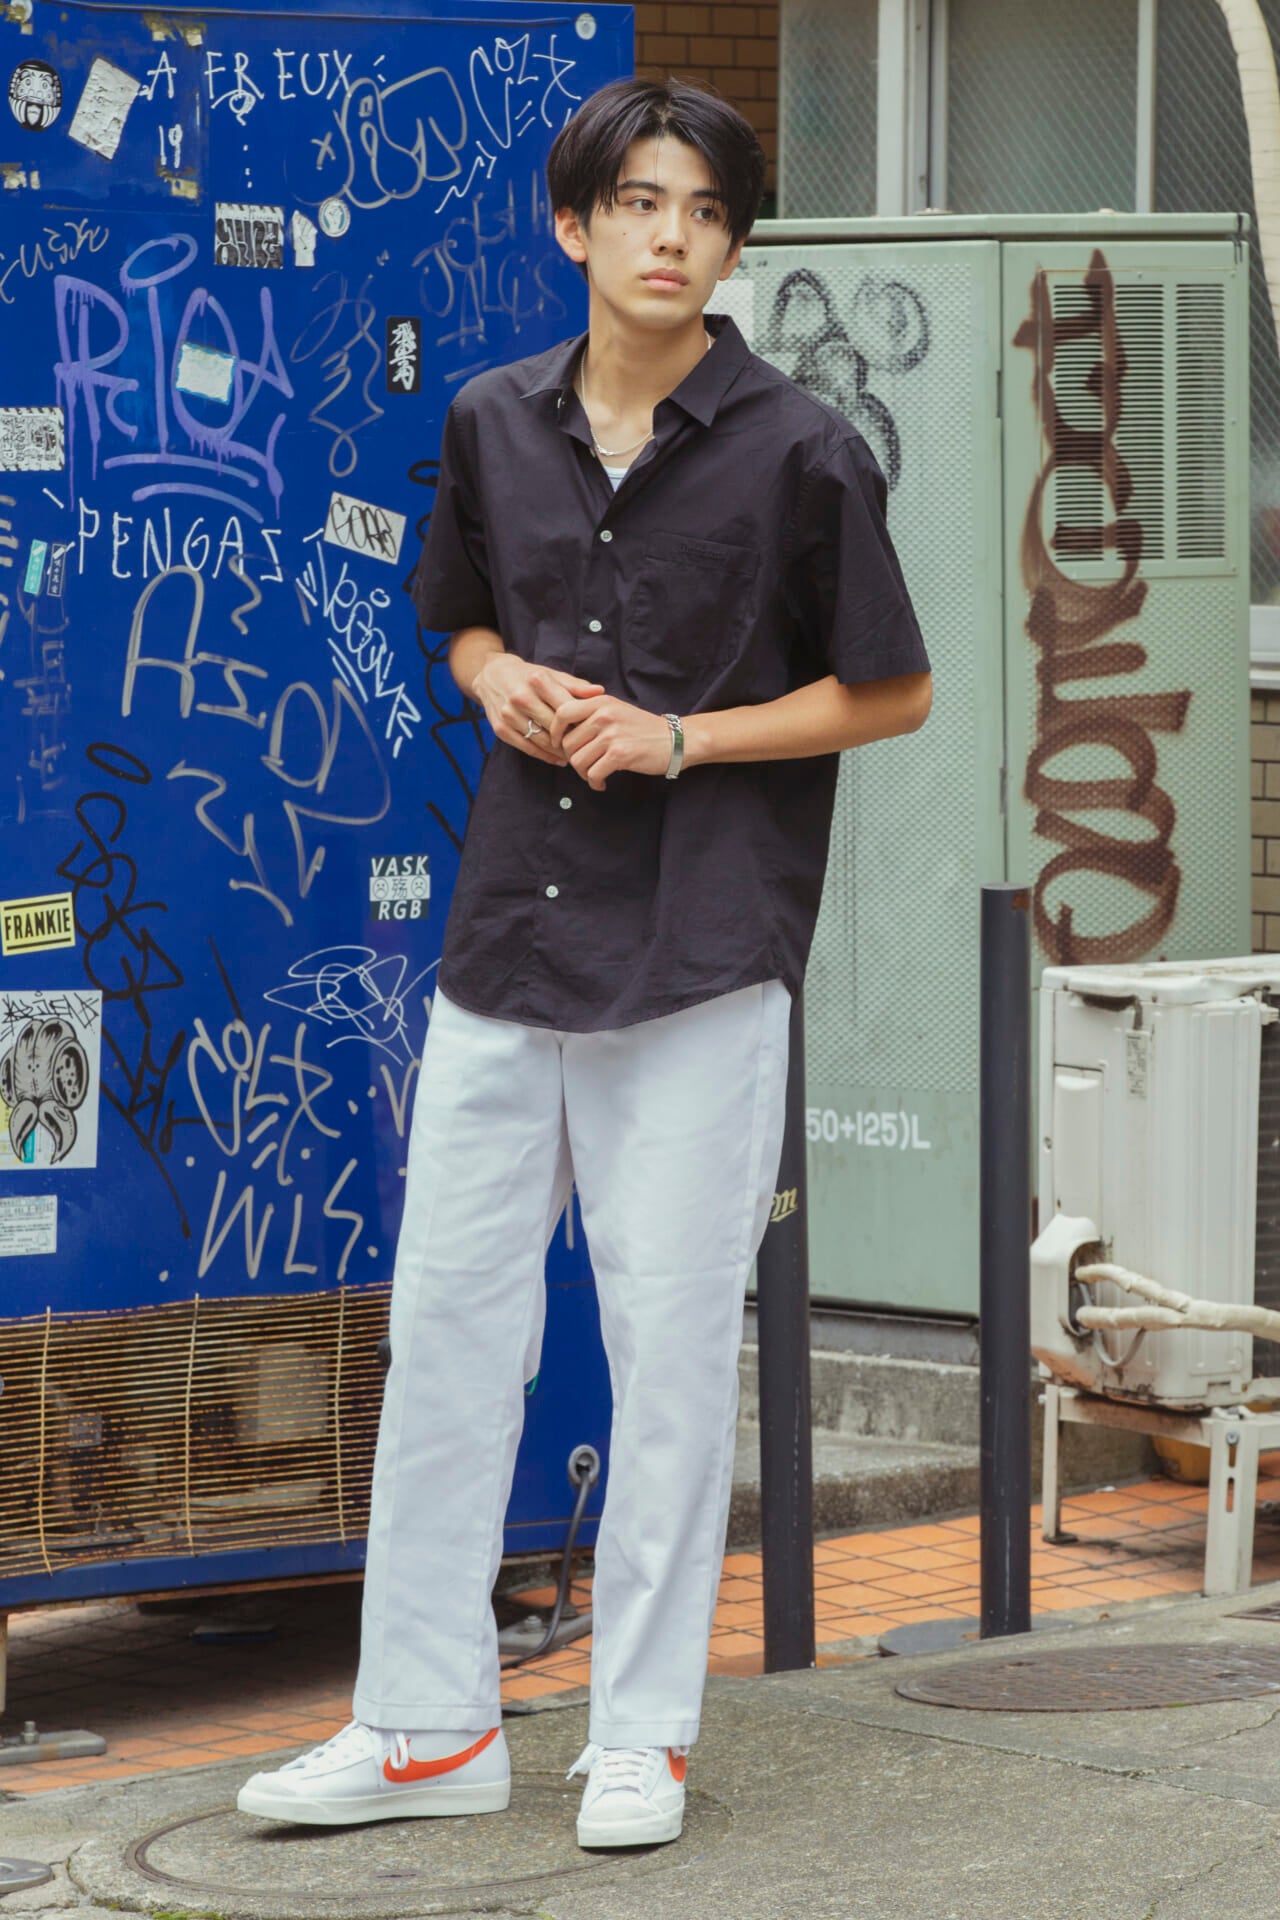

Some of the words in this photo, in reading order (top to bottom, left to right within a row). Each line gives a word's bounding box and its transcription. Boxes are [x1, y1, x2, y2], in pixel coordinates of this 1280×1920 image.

[371, 855, 429, 877] VASK
[378, 899, 422, 921] RGB
[4, 907, 71, 941] FRANKIE
